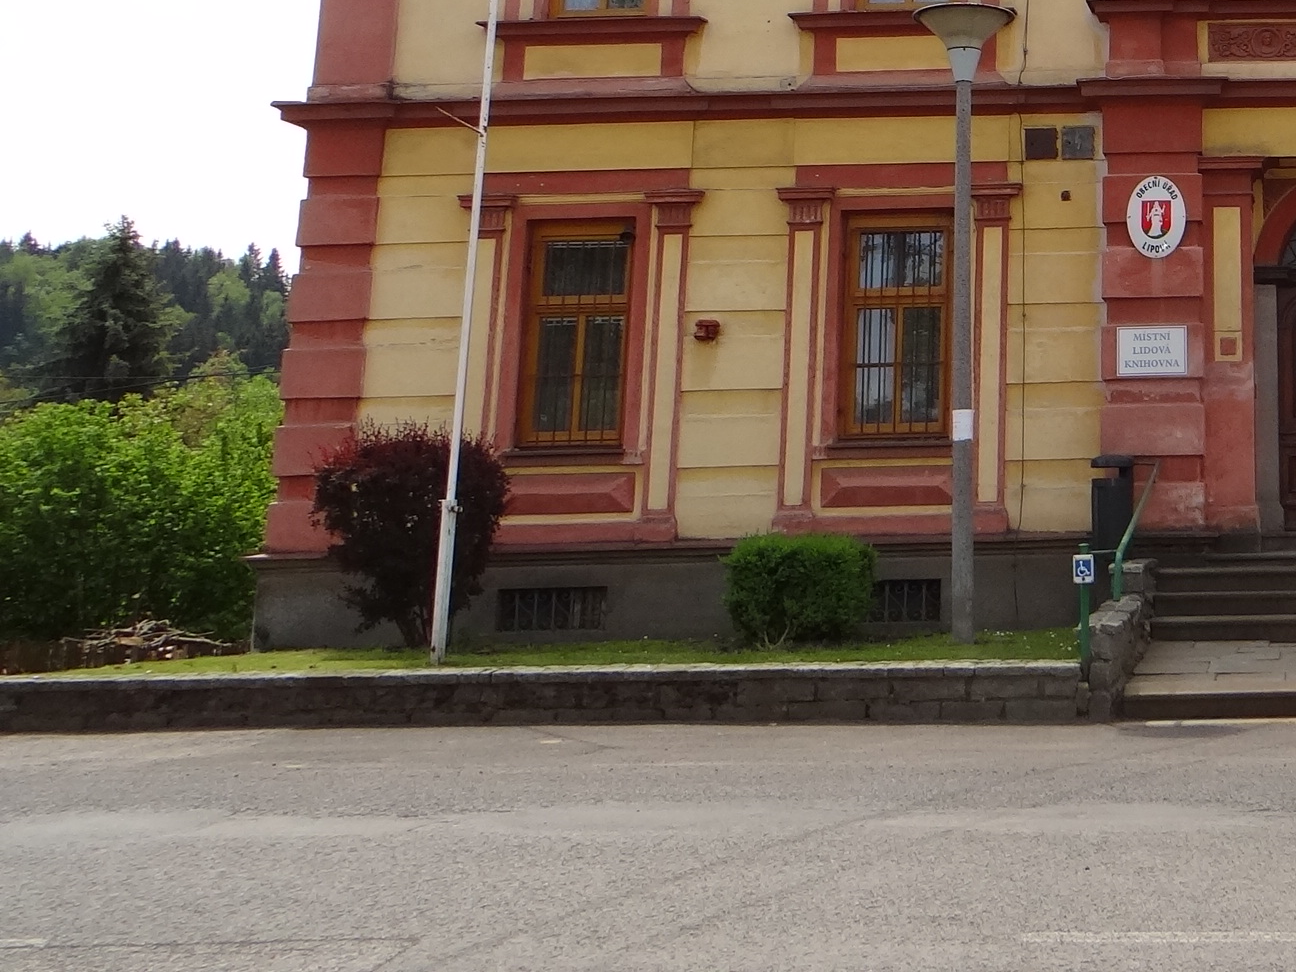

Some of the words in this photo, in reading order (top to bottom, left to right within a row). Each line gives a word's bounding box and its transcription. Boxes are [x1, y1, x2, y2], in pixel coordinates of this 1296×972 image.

[1136, 179, 1161, 199] OBECNÍ
[1162, 181, 1178, 200] ÚŘAD
[1133, 331, 1171, 342] MÍSTNÍ
[1132, 344, 1171, 355] LIDOVÁ
[1124, 359, 1180, 369] KNIHOVNA
